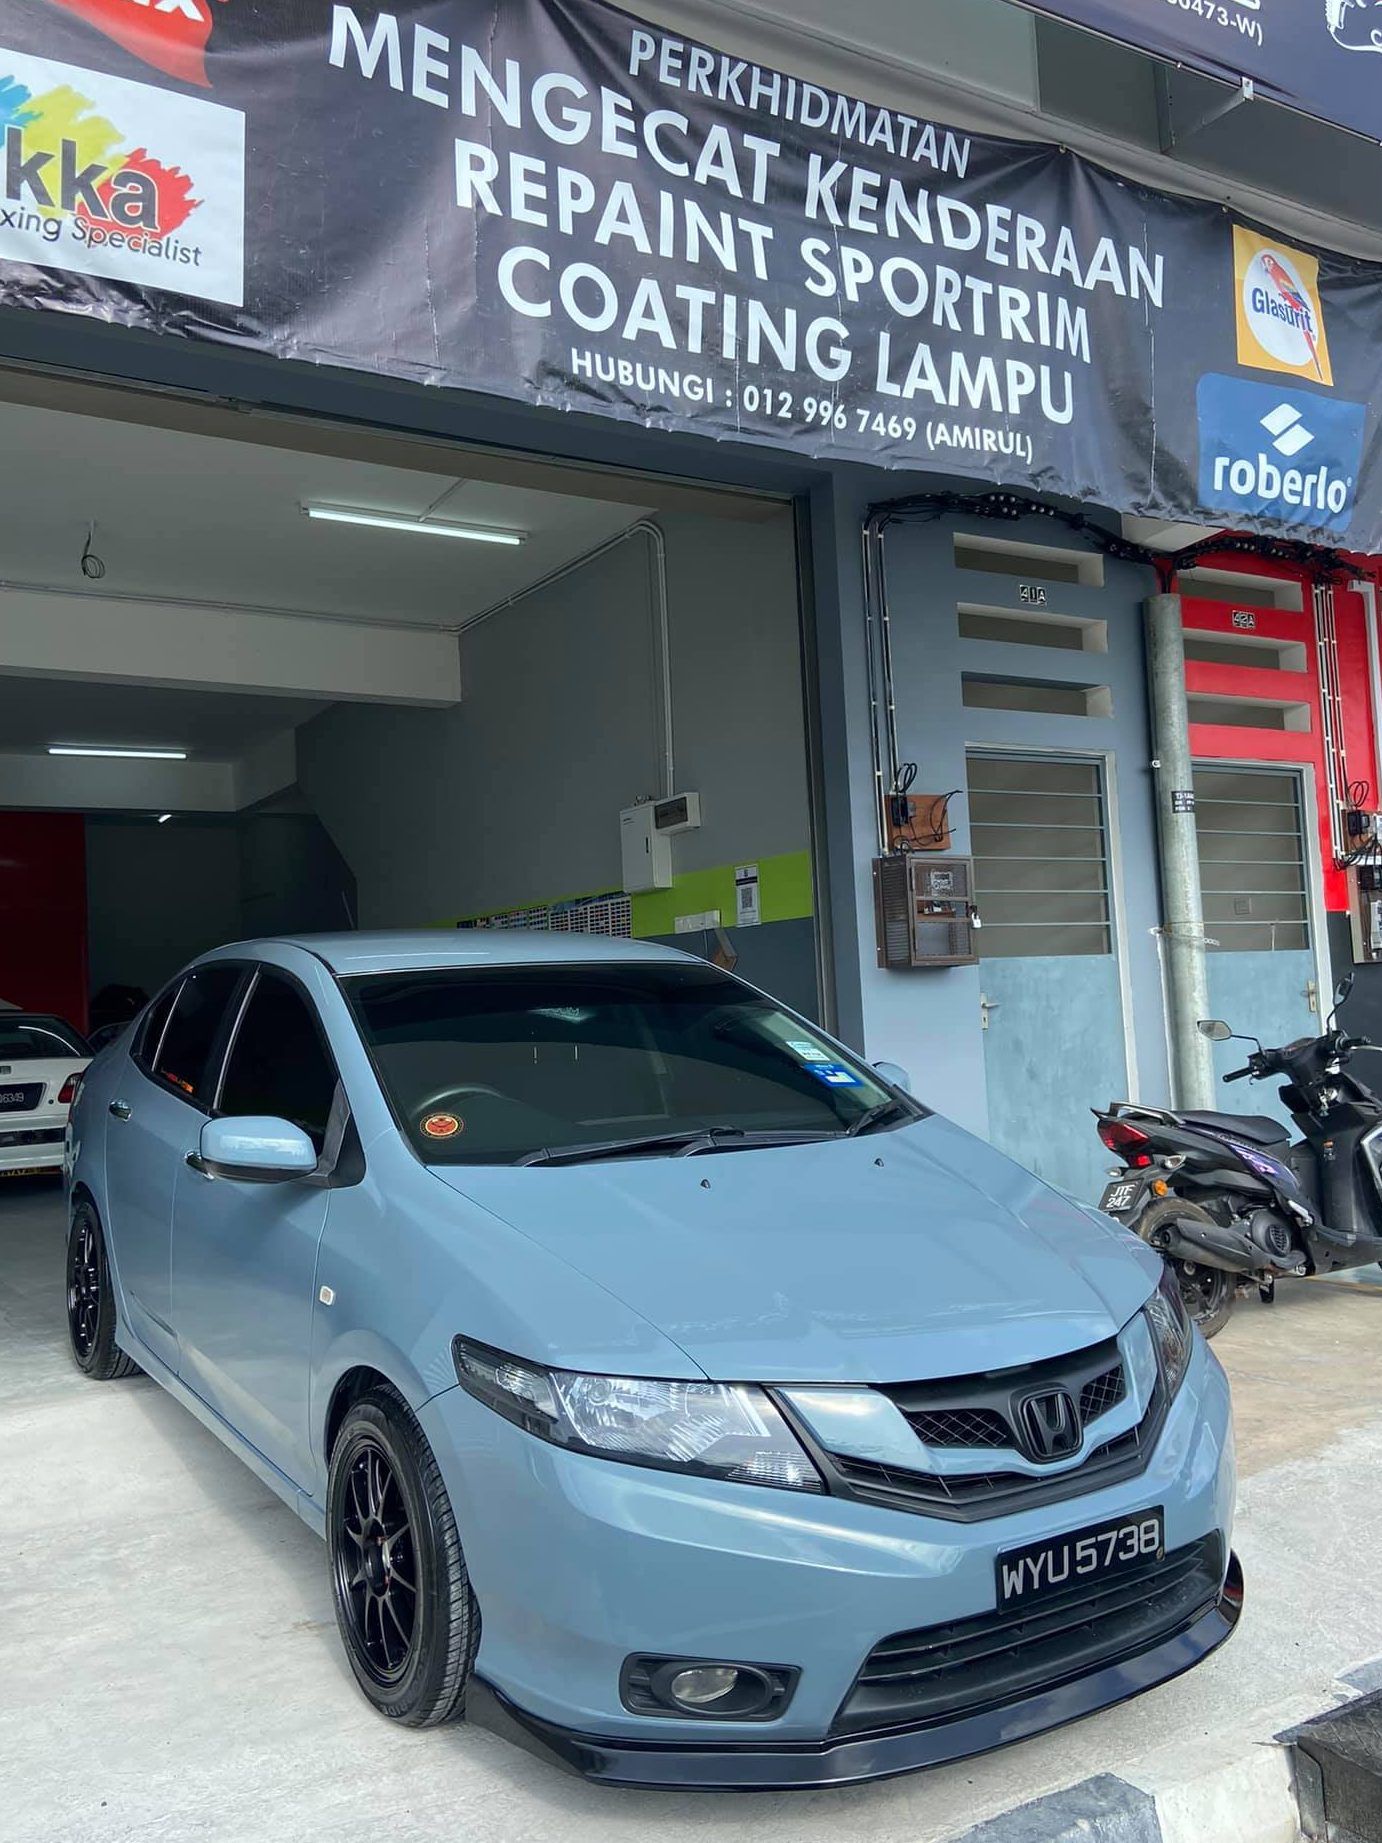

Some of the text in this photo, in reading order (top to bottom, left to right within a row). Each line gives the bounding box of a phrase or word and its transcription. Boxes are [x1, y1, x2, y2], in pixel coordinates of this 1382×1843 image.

[629, 29, 971, 179] PERKHIDMATAN
[329, 4, 1164, 309] MENGECAT KENDERAAN
[71, 213, 202, 267] Specialist
[454, 137, 1091, 364] REPAINT SPORTRIM
[497, 245, 1074, 425] COATING LAMPU
[1251, 287, 1314, 333] Glasurit
[571, 347, 714, 403] HUBUNGI
[744, 385, 793, 420] 012
[803, 397, 847, 430] 996
[857, 409, 917, 442] 7469
[926, 421, 1033, 465] (AMIRUL)
[1213, 453, 1348, 514] roberlo
[1106, 1195, 1131, 1208] 247
[1110, 1184, 1136, 1197] JTF
